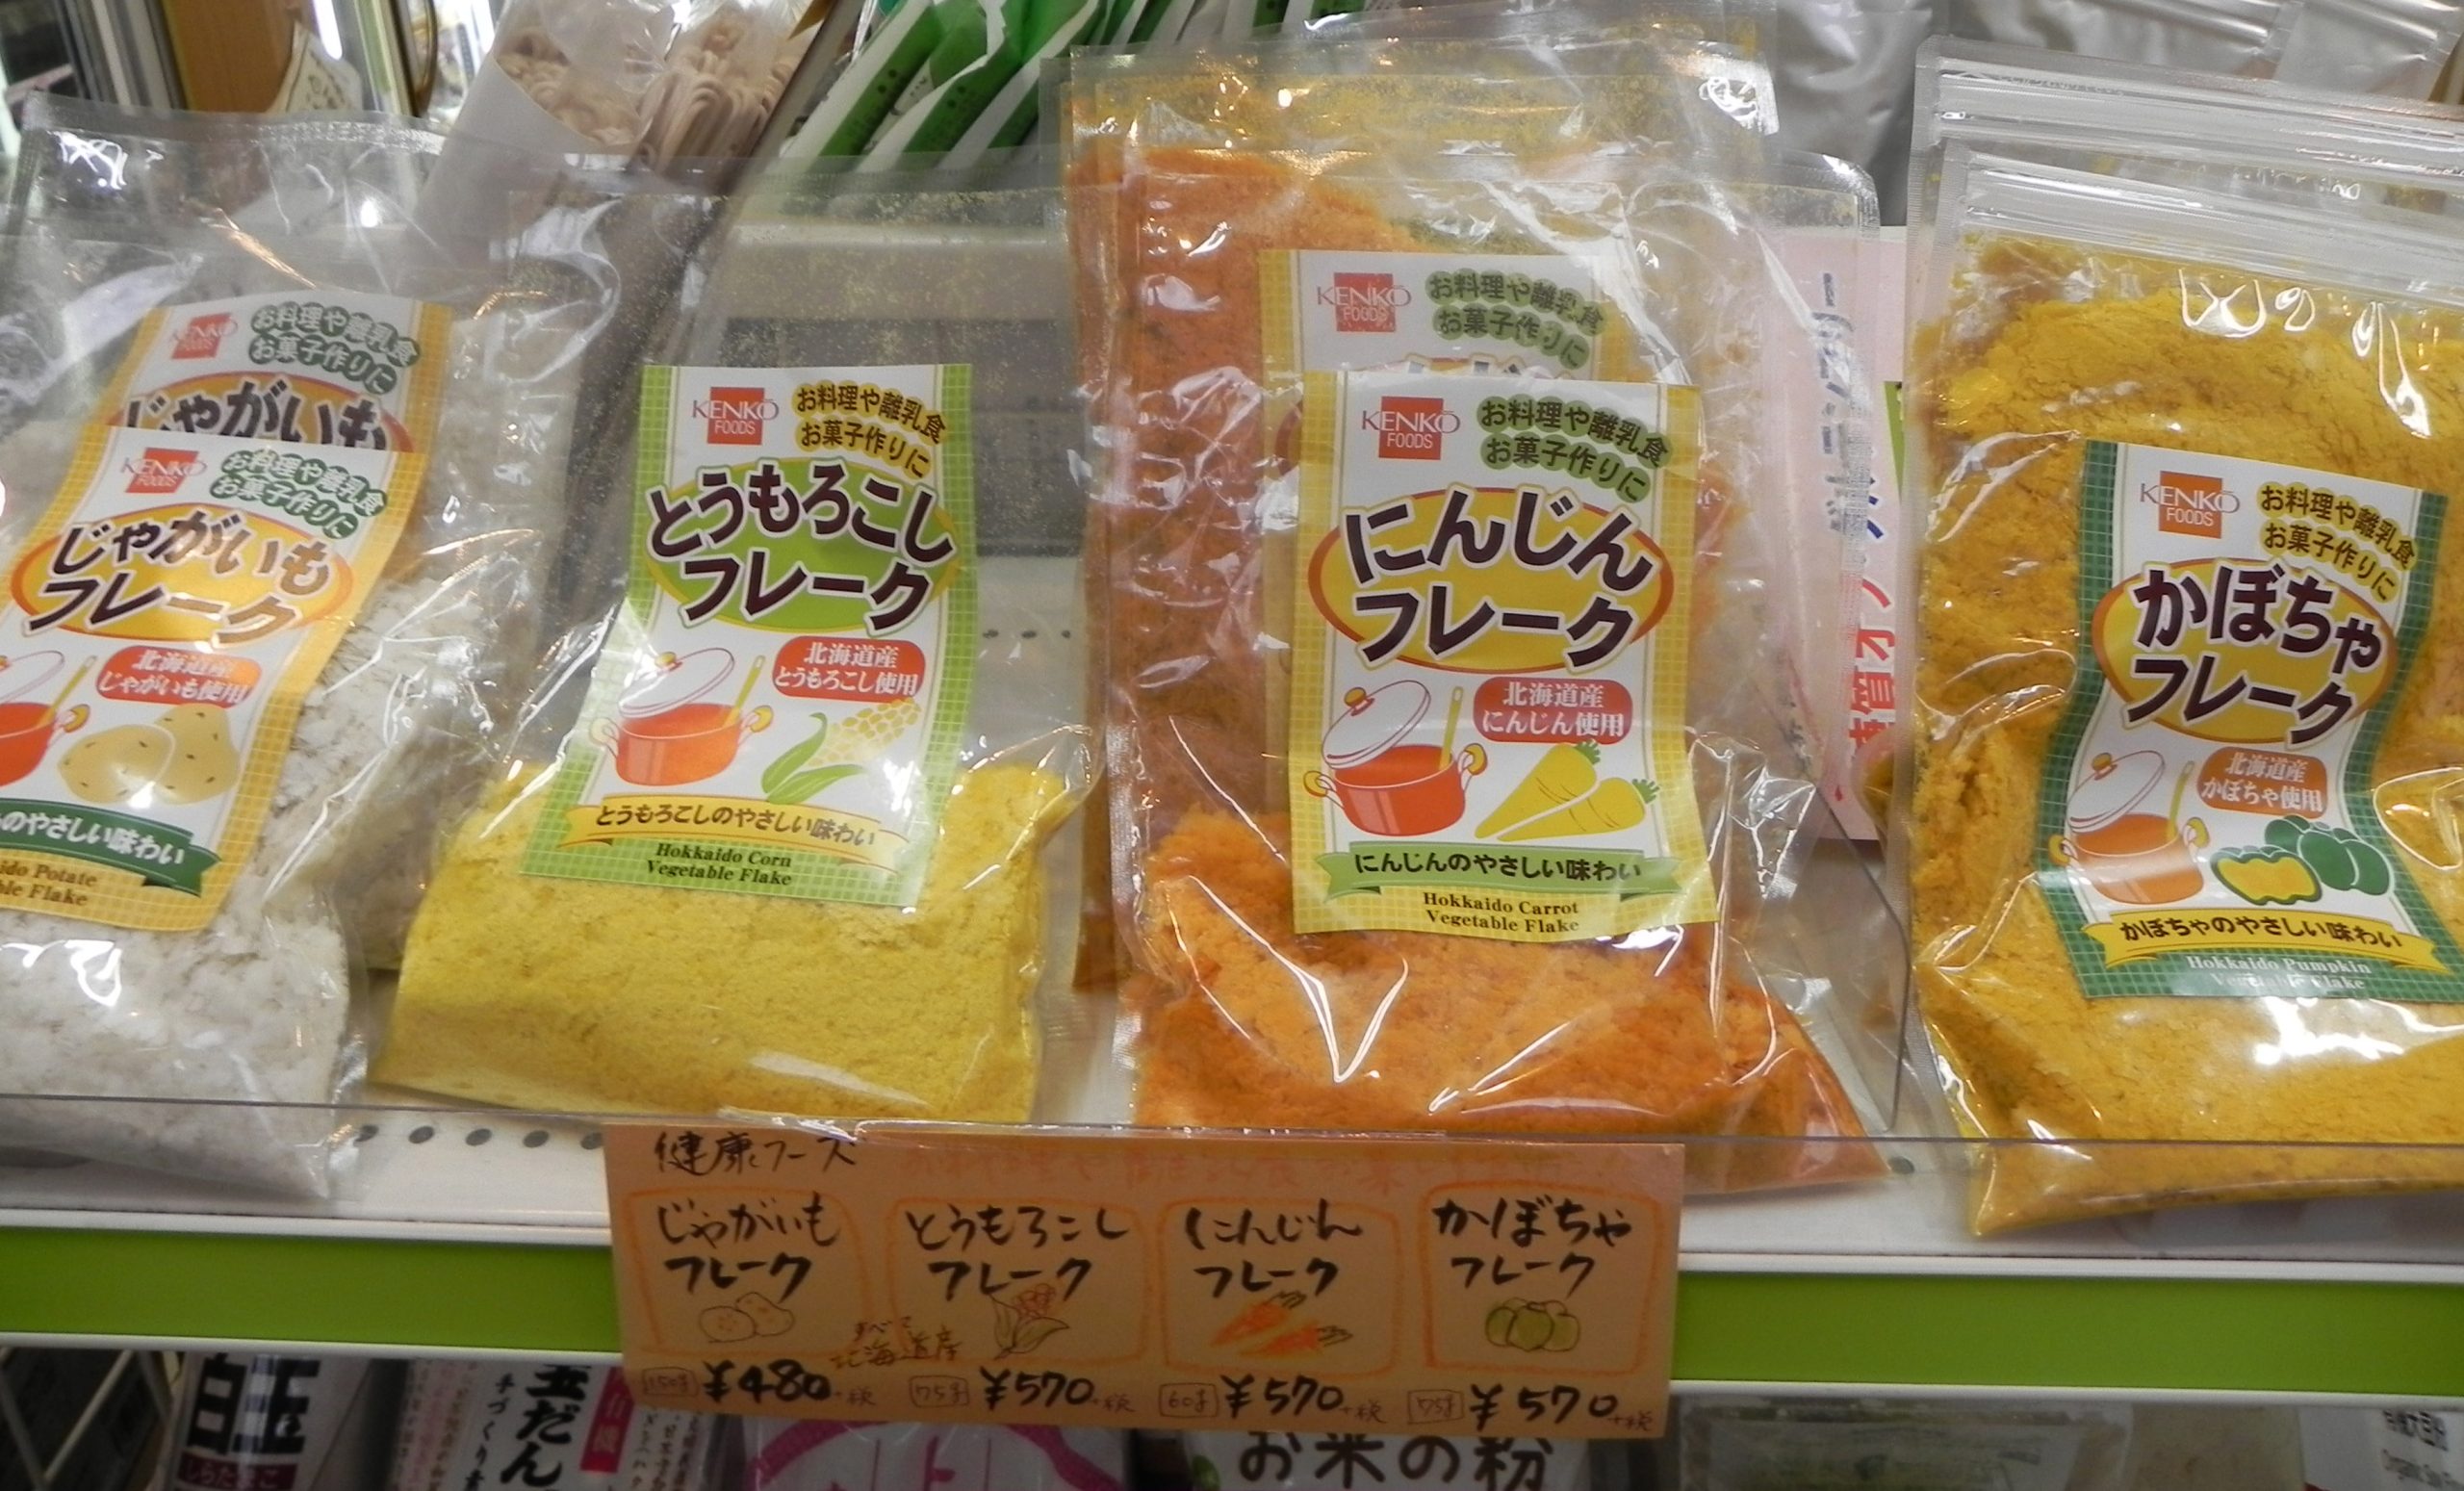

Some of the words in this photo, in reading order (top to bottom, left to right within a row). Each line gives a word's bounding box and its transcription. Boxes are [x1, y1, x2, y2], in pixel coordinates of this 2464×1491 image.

[1341, 306, 1388, 323] FOODS
[1429, 271, 1603, 336] お料理や離乳食
[253, 302, 418, 366] お料理や離乳食
[1437, 306, 1588, 369] お菓子作りに
[251, 335, 395, 393] お菓子作りに
[714, 420, 757, 435] FOODS
[797, 382, 946, 444] お料理や離乳食
[1481, 397, 1670, 468] お料理や離乳食
[801, 420, 930, 479] お菓子作りに
[1386, 432, 1434, 450] FOODS
[223, 450, 386, 514] お料理や離乳食
[1485, 436, 1651, 503] お菓子作りに
[212, 477, 358, 539] お菓子作りに
[648, 462, 955, 564] とうもろこし
[2165, 506, 2214, 528] FOODS
[2260, 483, 2417, 570] お料理や離乳食
[52, 510, 332, 596] じゃがいも
[1345, 489, 1655, 592] にんじん
[2264, 523, 2399, 603] お菓子作りに
[27, 572, 299, 647] フレーク
[682, 551, 931, 631] フレーク
[1355, 584, 1634, 668] フレーク
[2132, 561, 2383, 675] かぼちゃ
[804, 642, 899, 669] 北海道産
[774, 667, 918, 696] とうもろこし使用
[1502, 681, 1605, 709] 北海道産
[2126, 655, 2354, 746] フレーク
[1482, 708, 1625, 737] にんじん使用
[2224, 751, 2308, 784] 北海道産
[2199, 776, 2324, 813] かぼちゃ使用
[0, 810, 185, 864] のやさしい味わい
[595, 804, 876, 846] とうもろこしのやさしい味わい
[647, 860, 734, 884] Vegetable
[739, 867, 793, 887] Flake
[655, 843, 742, 864] Hokkaido
[748, 851, 792, 868] Corn
[1353, 852, 1642, 883] にんじんのやさしい味わい
[29, 884, 89, 906] Flake
[1423, 891, 1513, 914] Hokkaido
[1519, 900, 1578, 916] Carrot
[1426, 909, 1519, 934] Vegetable
[1525, 916, 1579, 934] Flake
[2118, 915, 2403, 949] かぼちゃのやさしい味わい
[2281, 956, 2373, 975] Pumpkin
[656, 1192, 841, 1249] じゃがいも
[903, 1203, 1131, 1251] とうもろこし
[1184, 1197, 1365, 1250] にんじん
[1431, 1193, 1634, 1248] かぼちゃ
[664, 1251, 813, 1304] フレーク
[928, 1257, 1092, 1302] フレーク
[1193, 1257, 1340, 1298] フレーク
[1450, 1251, 1597, 1299] フレーク
[703, 1358, 832, 1404] ¥480
[979, 1365, 1095, 1411] ¥570
[1220, 1374, 1345, 1420] ¥570
[1469, 1383, 1619, 1432] ¥570
[1239, 1430, 1553, 1491] お米の粉
